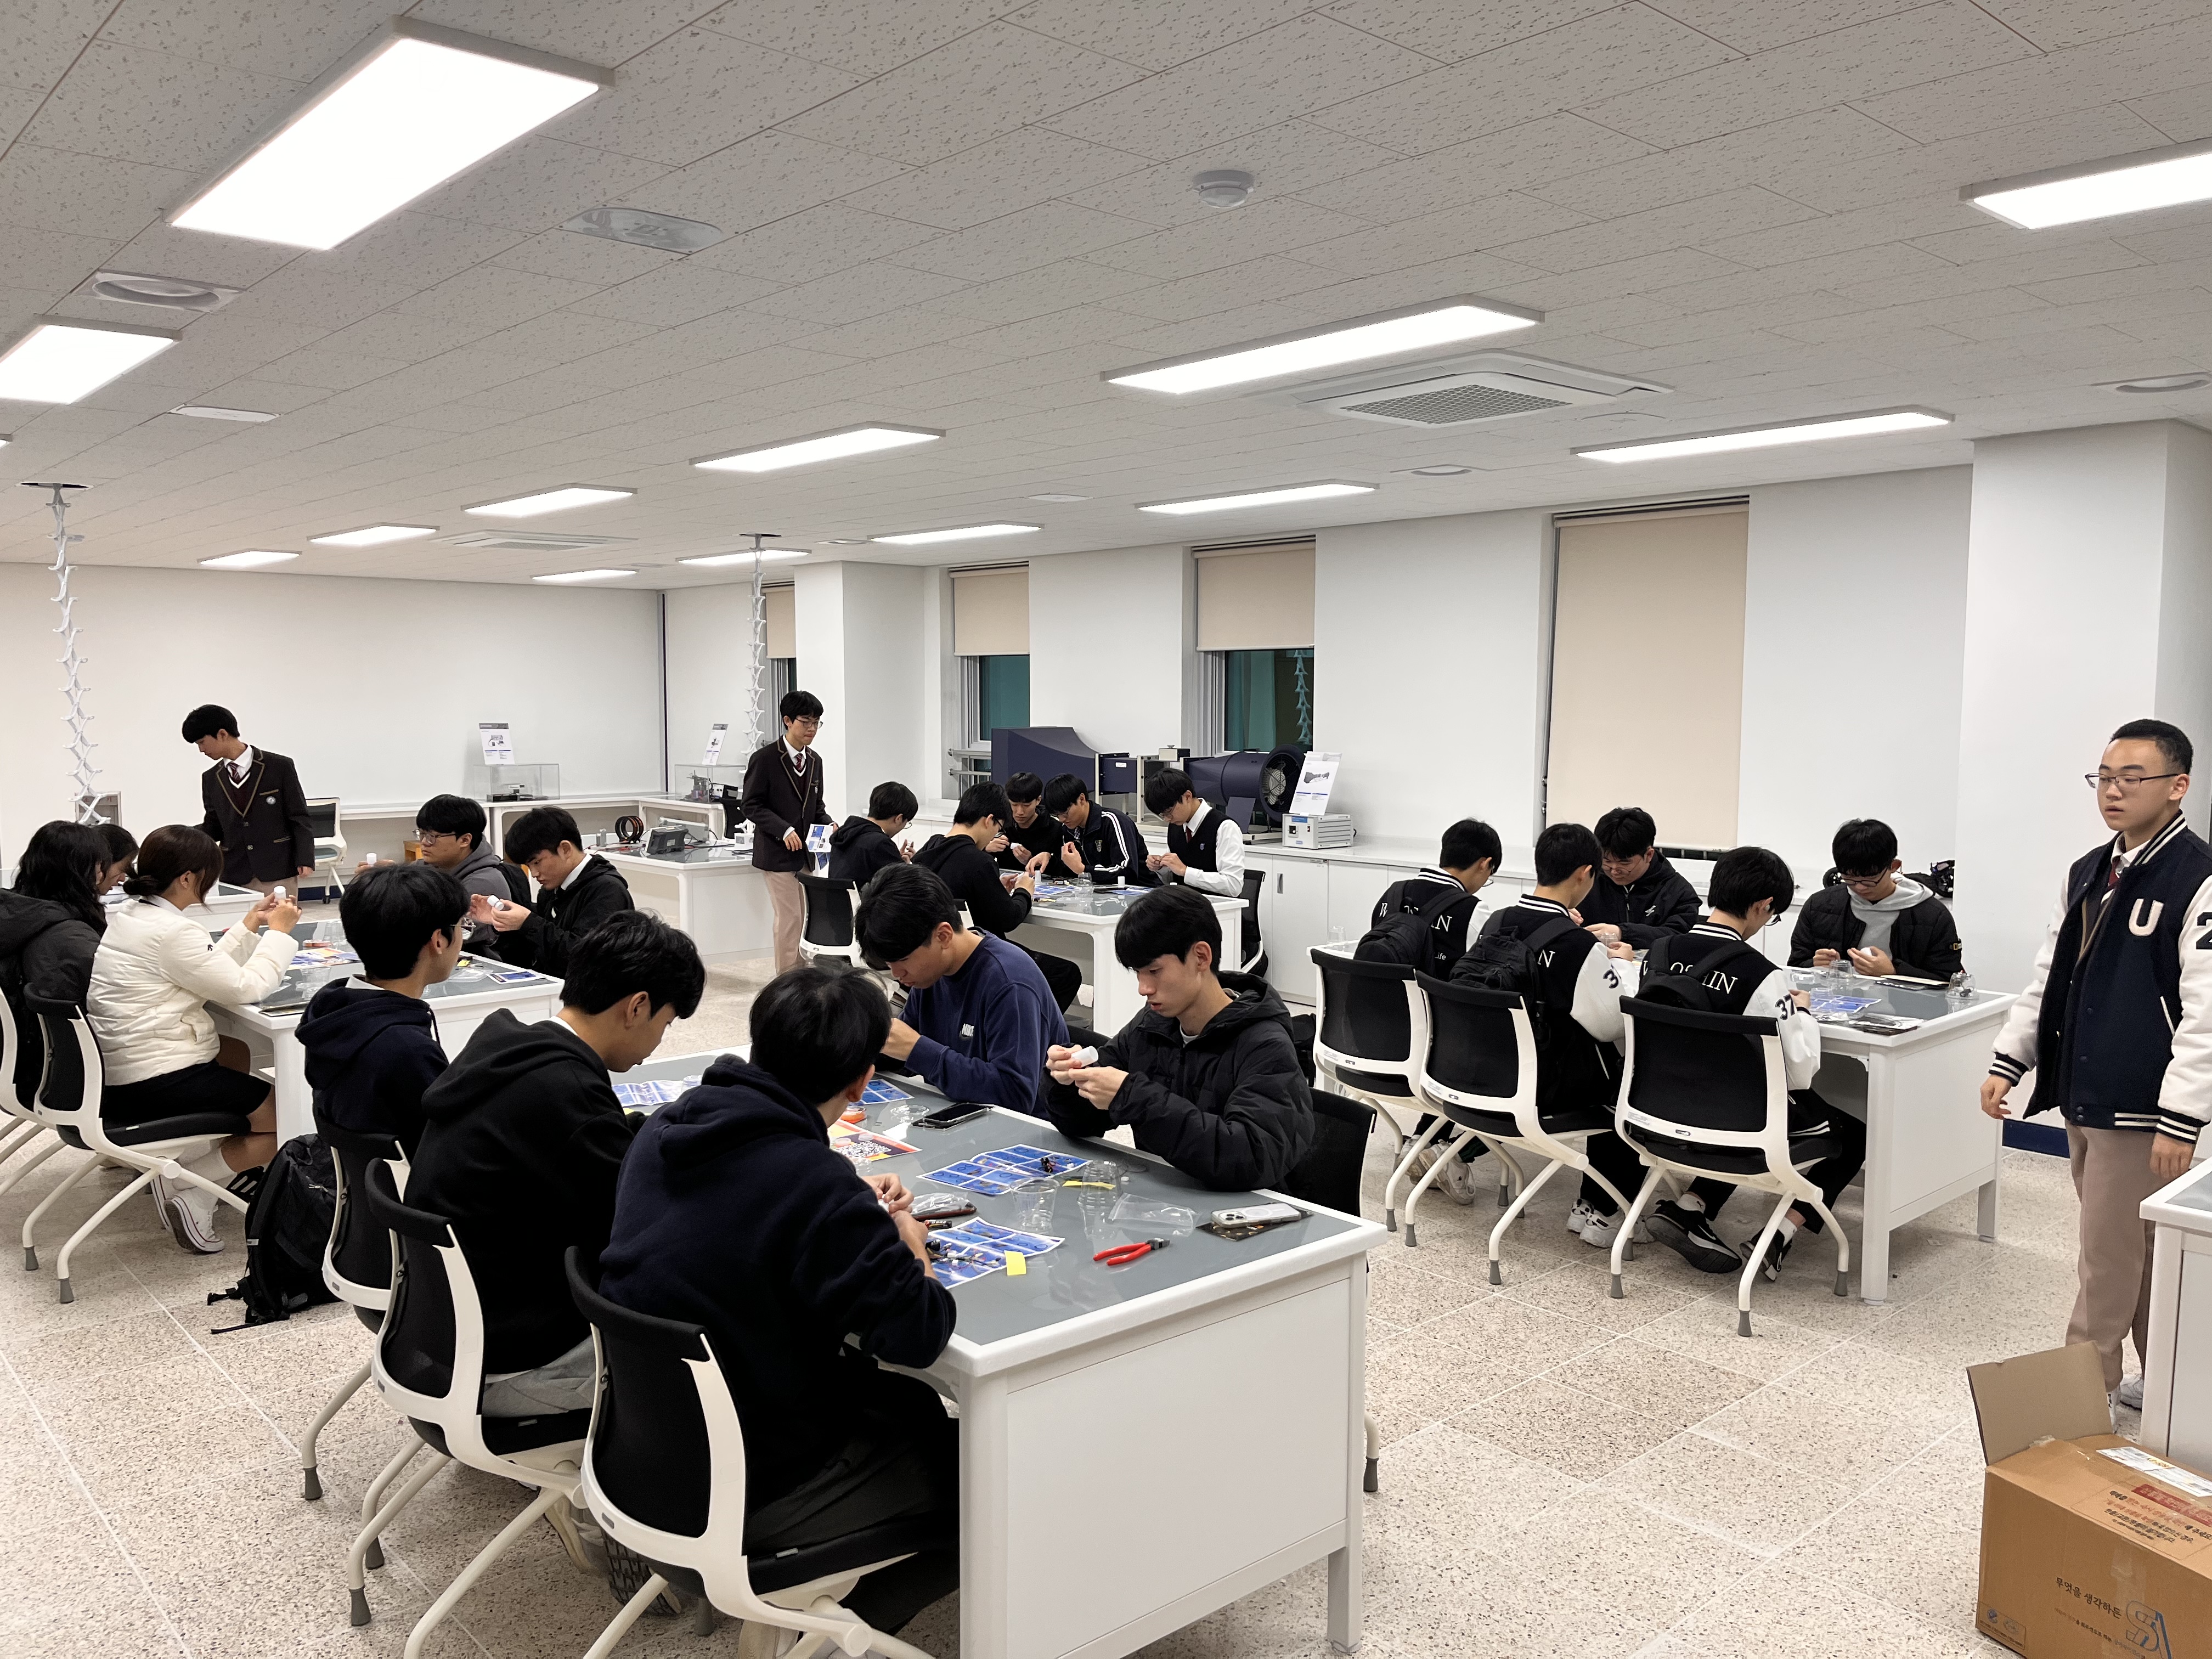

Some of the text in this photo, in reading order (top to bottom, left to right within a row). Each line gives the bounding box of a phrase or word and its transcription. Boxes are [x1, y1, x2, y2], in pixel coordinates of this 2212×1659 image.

[2129, 898, 2164, 936] U
[1775, 994, 1795, 1020] 37
[2056, 1577, 2081, 1598] 무엇을
[2084, 1593, 2121, 1620] 생각하든
